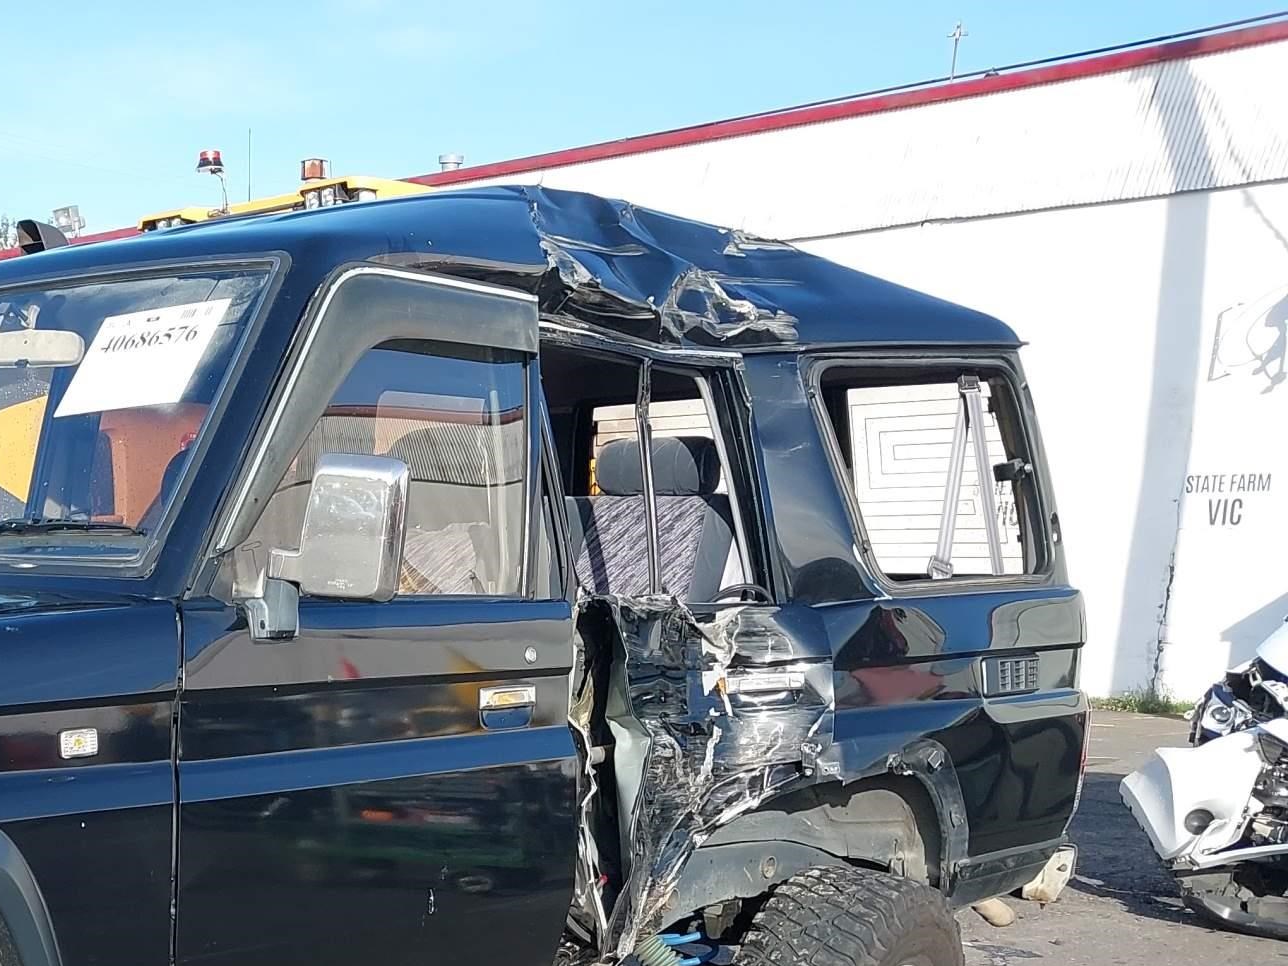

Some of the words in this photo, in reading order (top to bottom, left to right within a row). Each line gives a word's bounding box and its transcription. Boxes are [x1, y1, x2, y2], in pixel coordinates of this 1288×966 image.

[100, 325, 198, 353] 40686576
[1185, 474, 1227, 494] STATE
[1230, 472, 1272, 492] FARM
[1208, 498, 1243, 526] VIC
